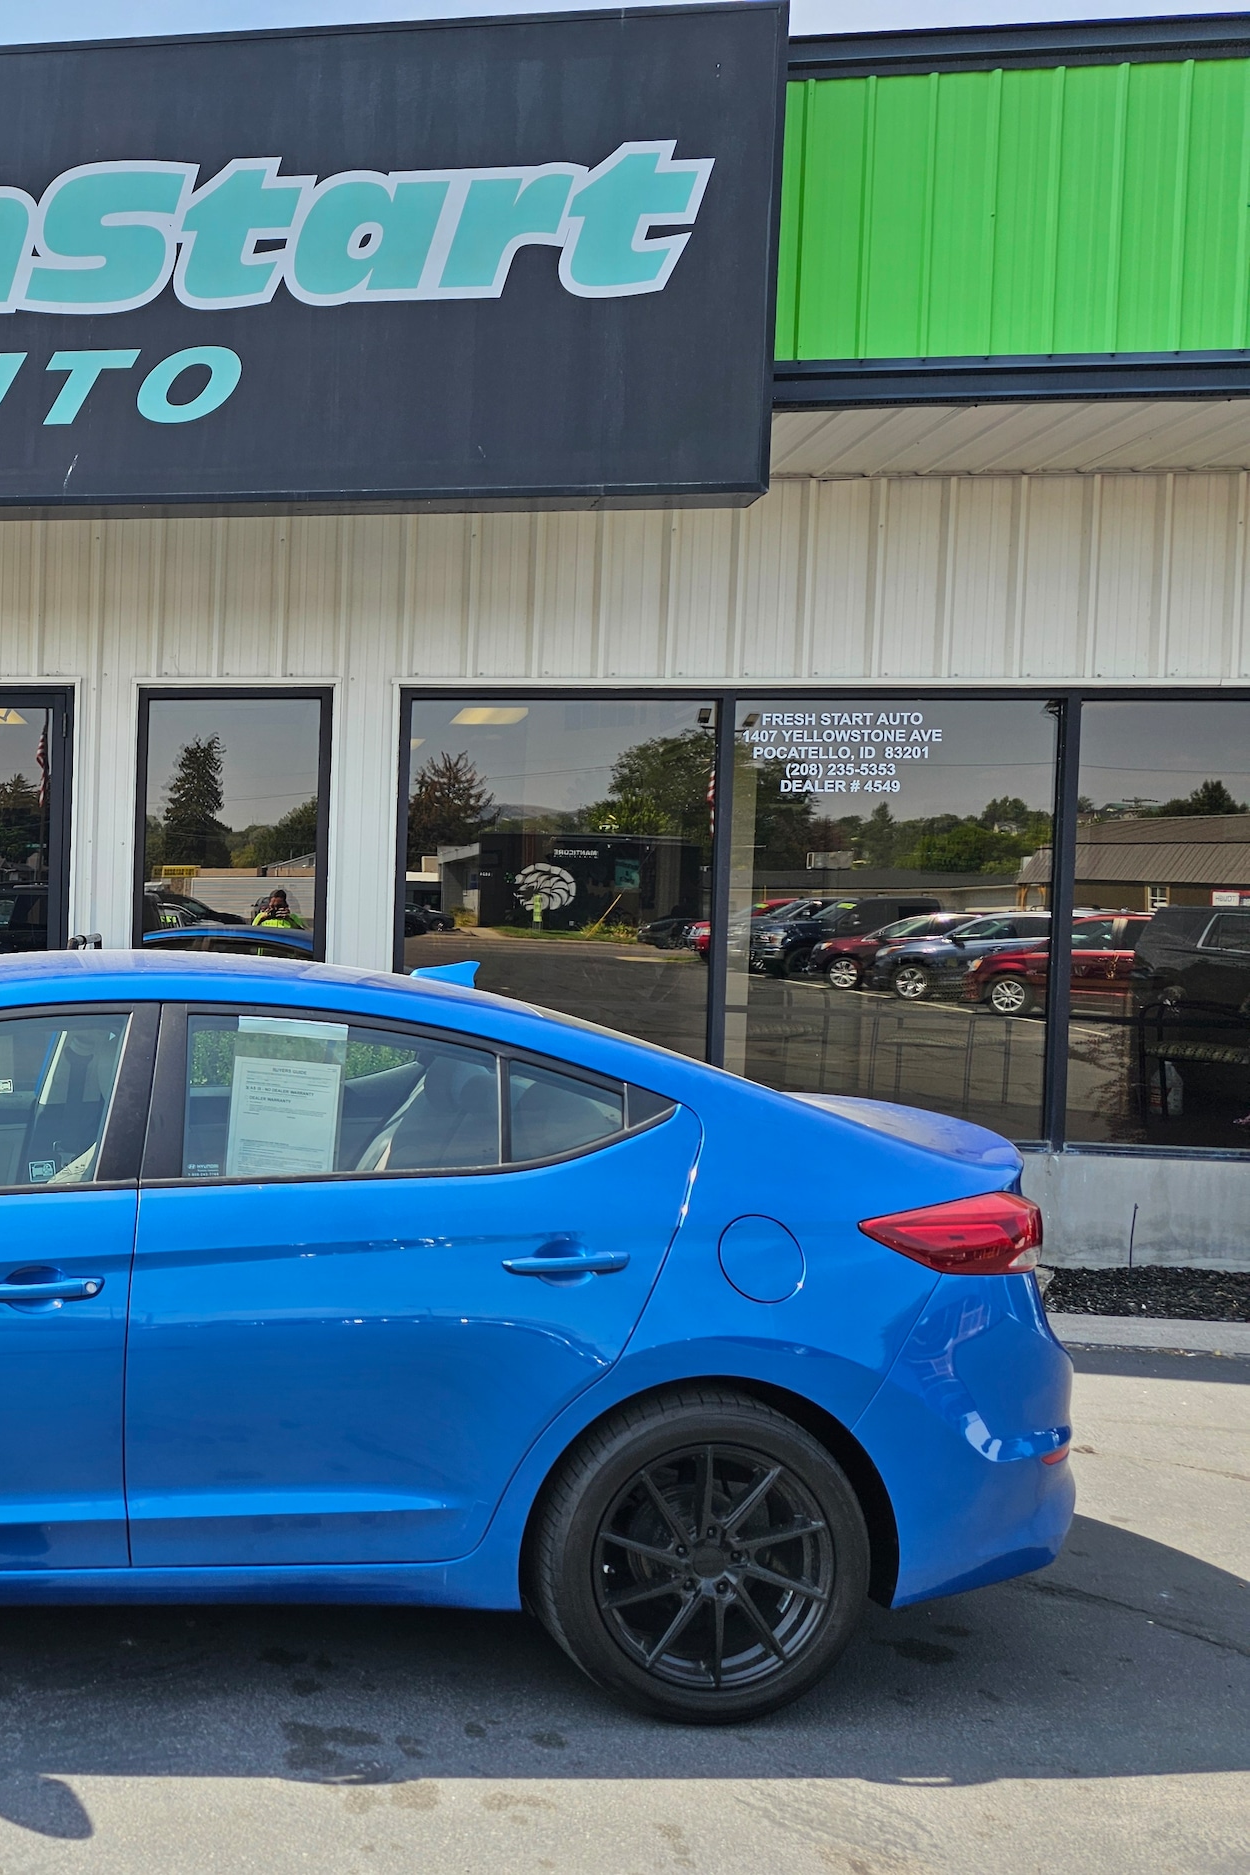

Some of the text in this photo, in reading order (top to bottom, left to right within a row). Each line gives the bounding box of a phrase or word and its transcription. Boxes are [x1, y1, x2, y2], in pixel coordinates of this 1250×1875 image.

[762, 712, 923, 726] FRESH START AUTO
[742, 729, 942, 743] 1407 YELLOWSTONE AVE
[753, 746, 929, 761] POCATELLO, ID 83201
[785, 763, 896, 778] (208) 235-5353
[780, 780, 900, 793] DEALER # 4549
